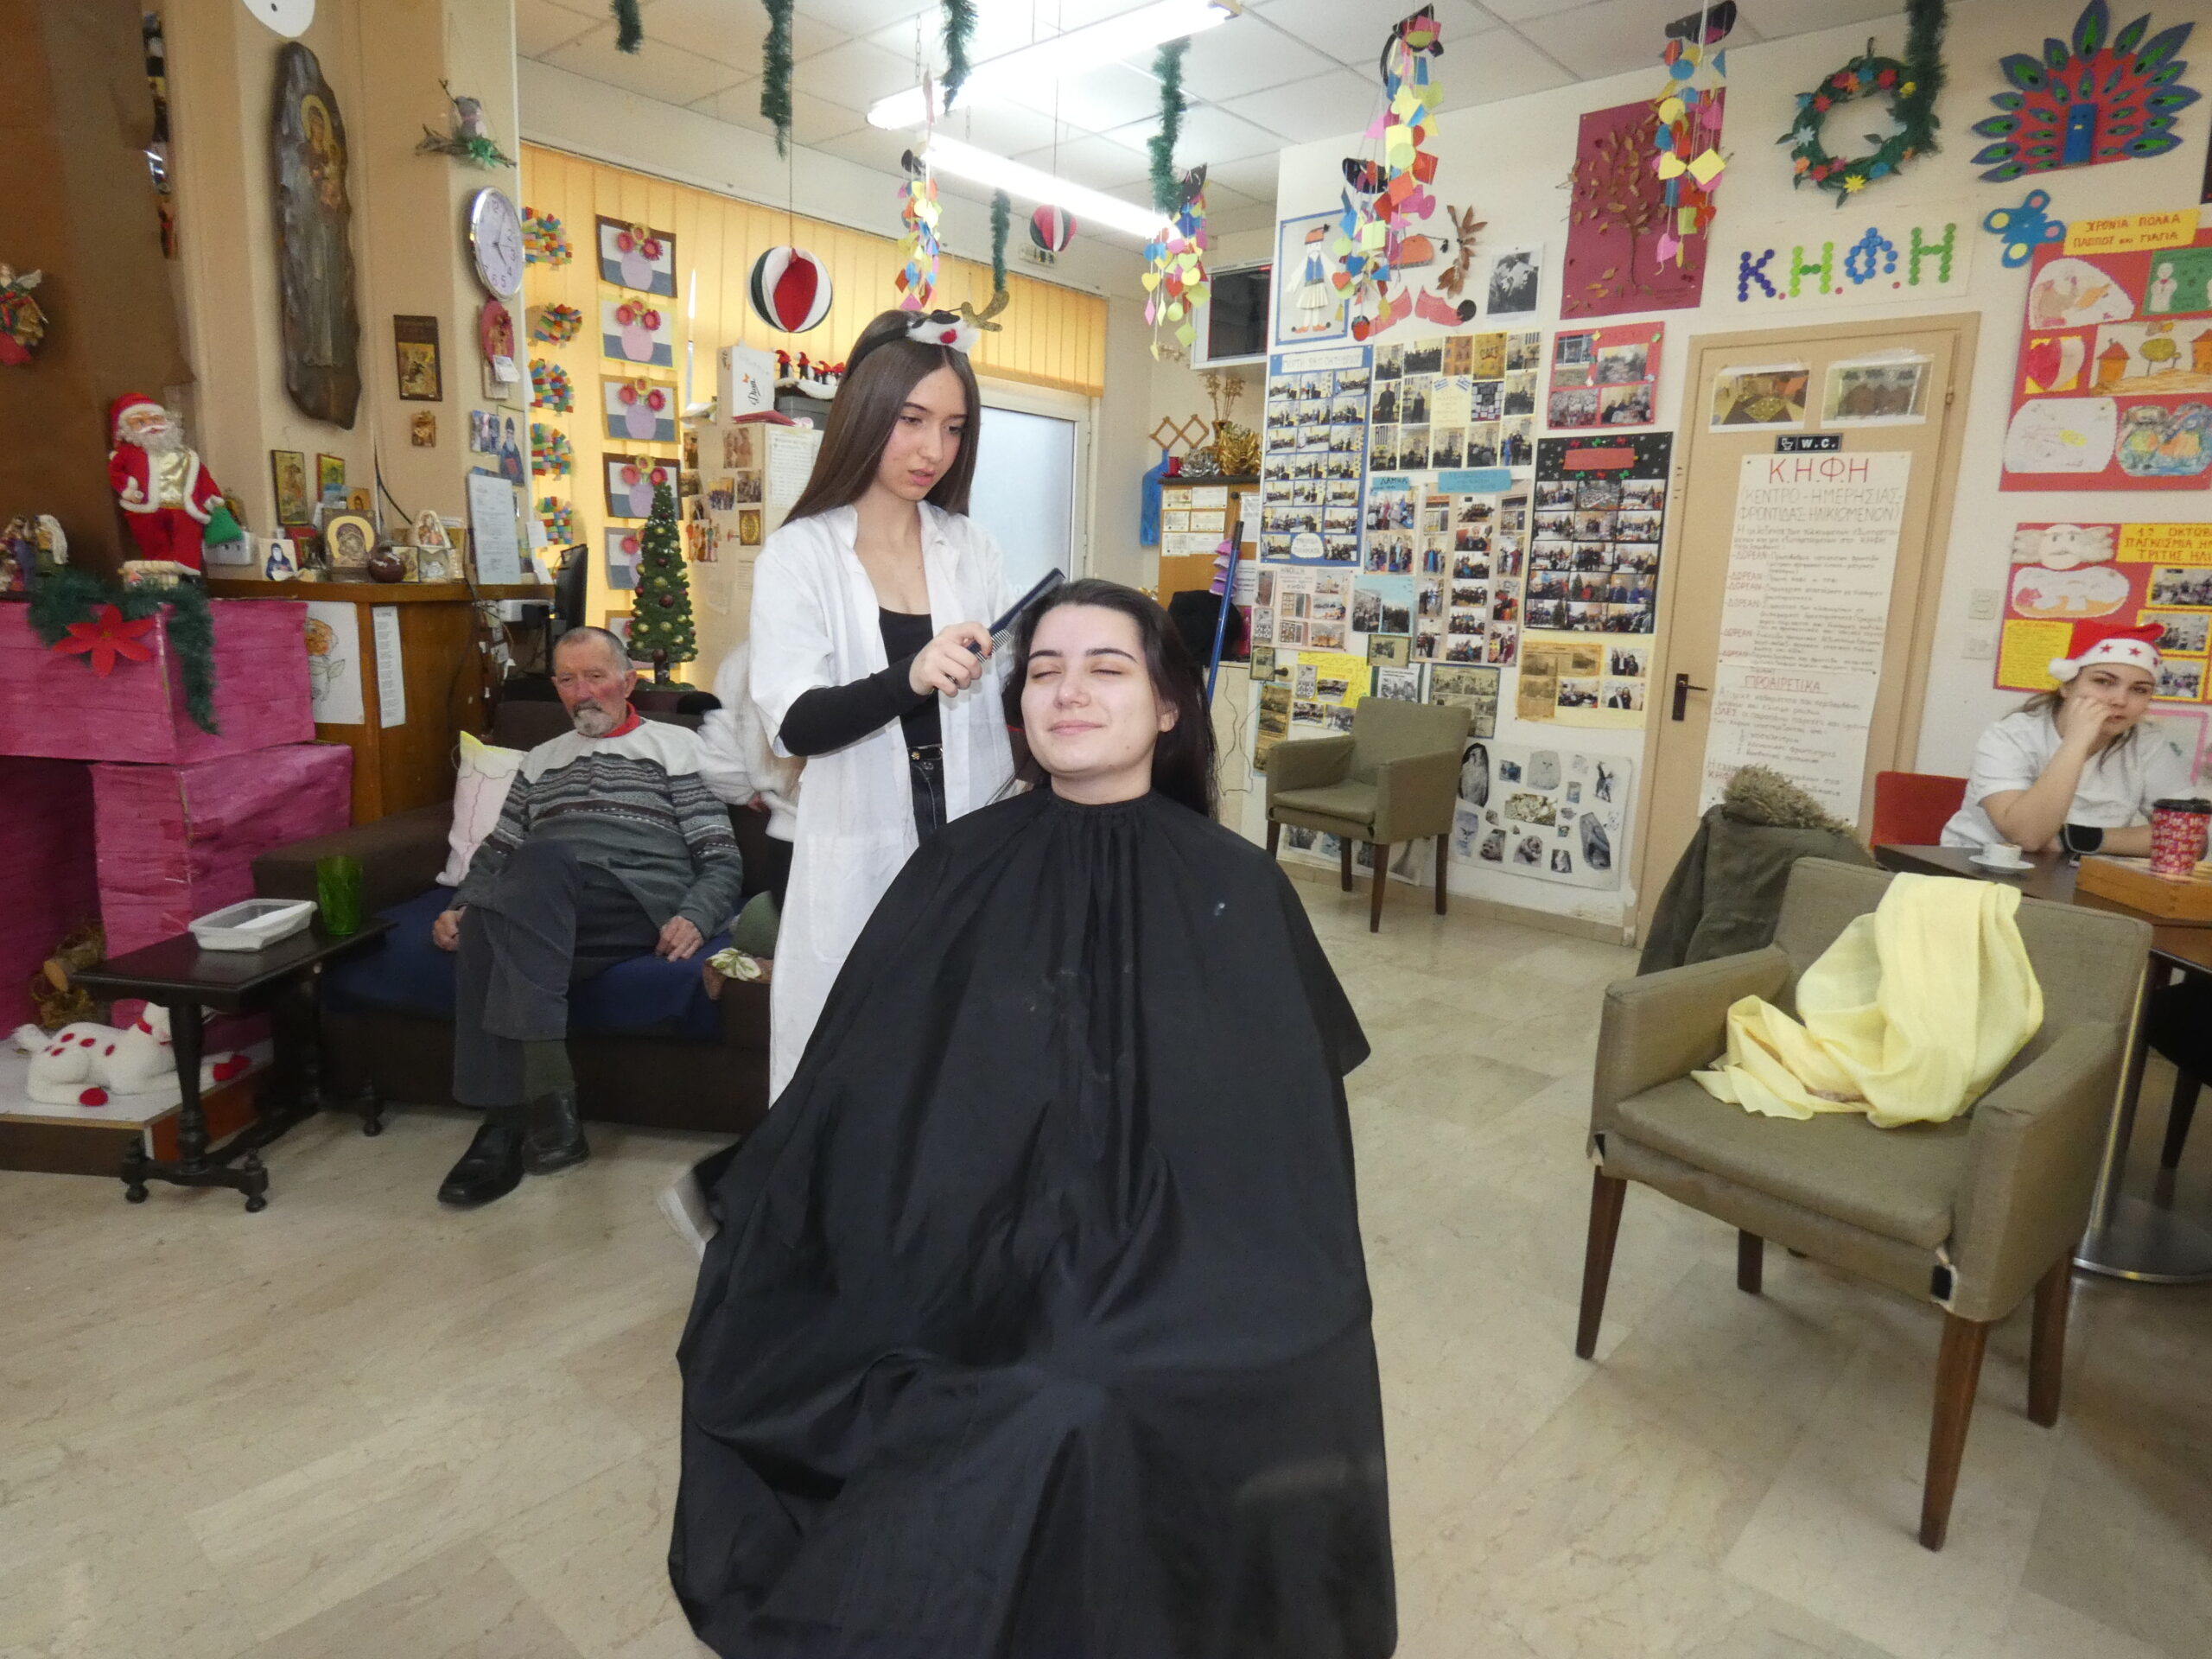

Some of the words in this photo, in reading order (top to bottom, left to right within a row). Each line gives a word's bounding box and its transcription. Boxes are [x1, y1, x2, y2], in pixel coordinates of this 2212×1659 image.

[2086, 219, 2129, 232] ΧΡΟΝΙΑ
[2139, 214, 2181, 227] ΠΟΛΛΑ
[2140, 232, 2178, 243] ΓΙΑΓΙΑ
[1801, 438, 1836, 449] W.C.
